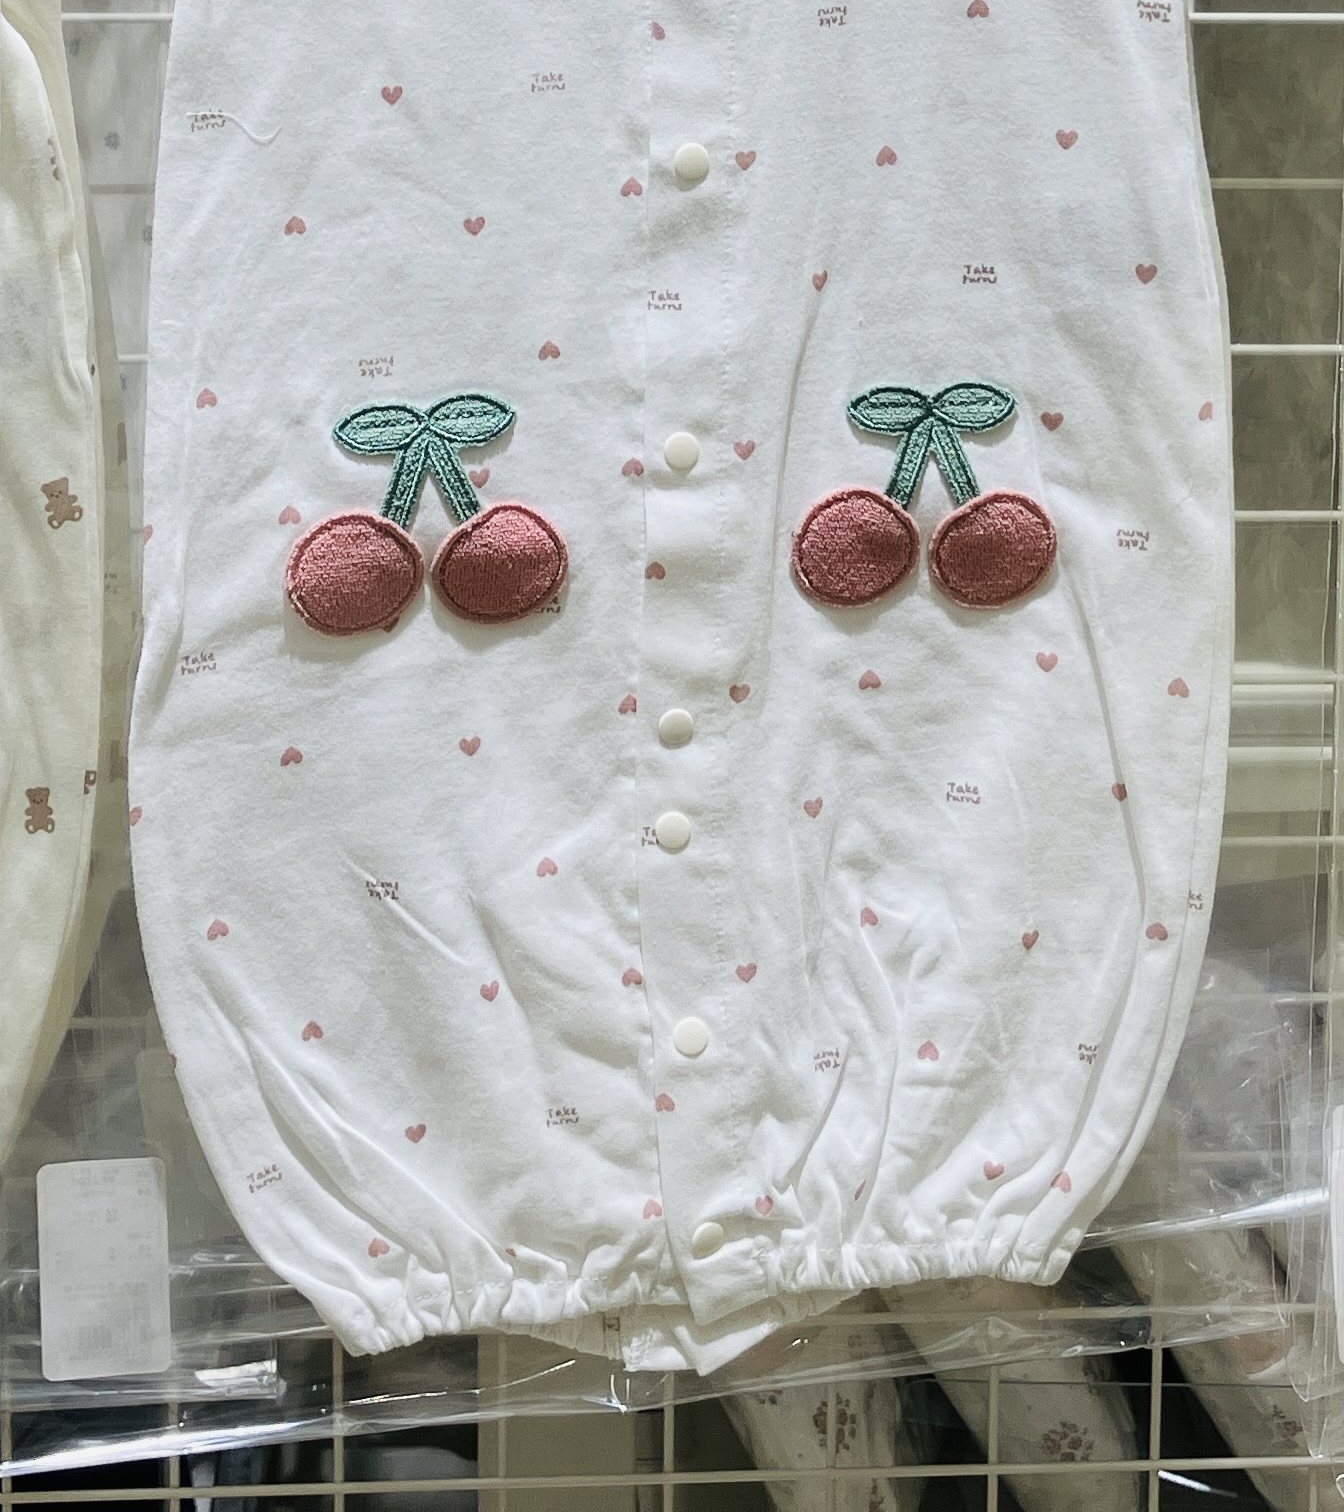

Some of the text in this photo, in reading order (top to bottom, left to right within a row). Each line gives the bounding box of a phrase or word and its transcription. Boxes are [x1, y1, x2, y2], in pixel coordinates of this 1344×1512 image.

[819, 15, 847, 29] Take
[1138, 10, 1171, 24] Take
[531, 72, 565, 85] Take
[963, 263, 996, 276] Take
[648, 289, 681, 302] Take
[359, 367, 393, 381] Take
[1117, 538, 1149, 552] Take
[182, 651, 216, 667] Take
[947, 782, 981, 796] Take
